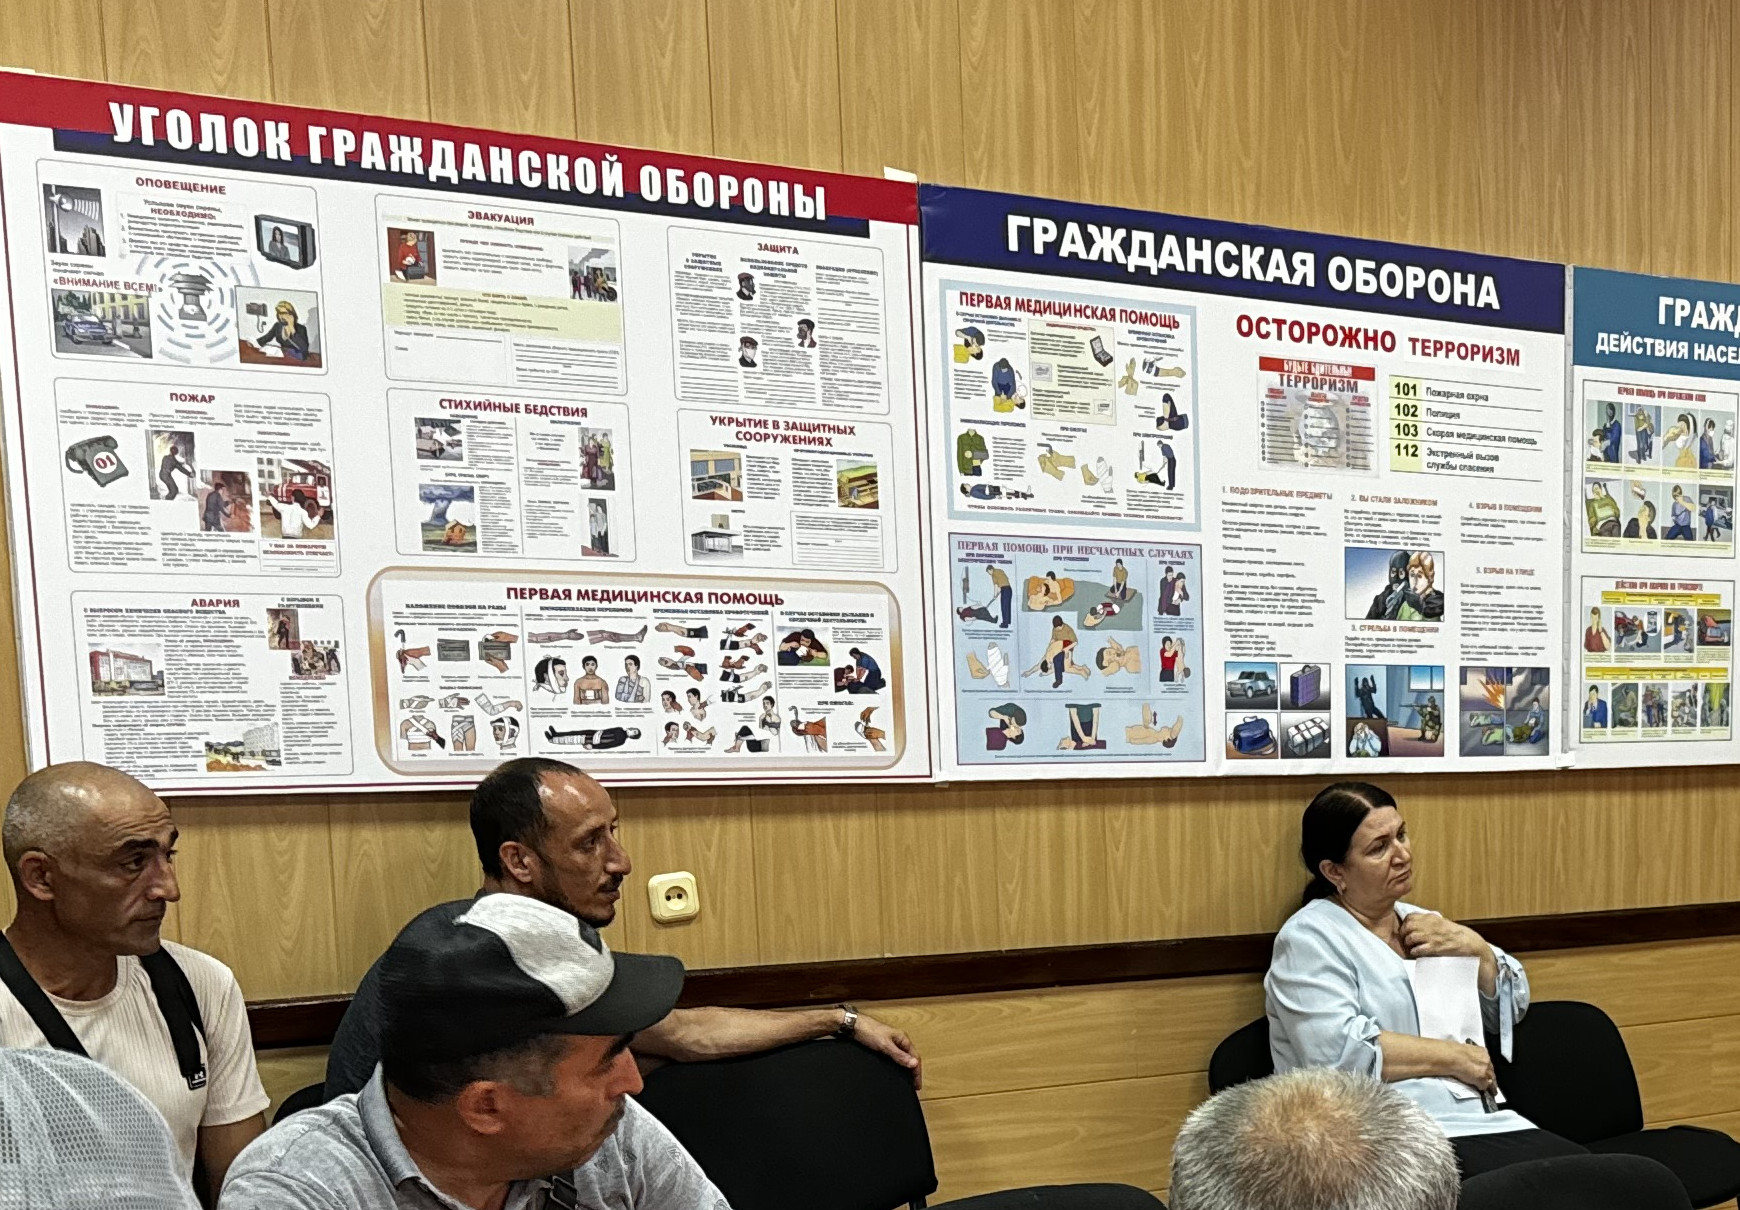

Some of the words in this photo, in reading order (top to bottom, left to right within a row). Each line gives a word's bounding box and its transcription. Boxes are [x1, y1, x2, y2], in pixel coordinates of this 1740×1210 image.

[108, 101, 292, 161] УГОЛОК
[307, 125, 625, 198] ГРАЖДАНСКОЙ
[639, 164, 826, 221] ОБОРОНЫ
[135, 176, 227, 195] ОПОВЕЩЕНИЕ
[467, 210, 535, 226] ЭВАКУАЦИЯ
[757, 242, 799, 256] ЗАЩИТА
[1007, 214, 1315, 287] ГРАЖДАНСКАЯ
[1327, 256, 1501, 310] ОБОРОНА
[53, 277, 120, 291] «ВНИМАНИЕ
[959, 291, 1012, 311] ПЕРВАЯ
[1015, 297, 1116, 323] МЕДИЦИНСКАЯ
[1119, 309, 1181, 331] ПОМОЩЬ
[1236, 314, 1397, 353] ОСТОРОЖНО
[1408, 336, 1521, 367] ТЕРРОРИЗМ
[1595, 331, 1689, 360] ДЕЙСТВИЯ
[1278, 373, 1359, 393] ТЕРРОРИЗМ
[1394, 382, 1417, 397] 101
[1426, 386, 1464, 400] Пожарная
[169, 392, 216, 404] ПОЖАР
[438, 398, 521, 414] СТИХИЙНЫЕ
[524, 403, 589, 418] БЕДСТВИЯ
[1394, 403, 1418, 417] 102
[1426, 407, 1460, 419] Полиция
[709, 415, 769, 429] УКРЫТИЕ
[773, 420, 781, 430] В
[783, 421, 857, 436] ЗАЩИТНЫХ
[1394, 422, 1418, 437] 103
[1426, 427, 1454, 439] Скорая
[1456, 431, 1506, 443] медицинская
[1508, 436, 1537, 446] помощь
[735, 431, 834, 447] СООРУЖЕНИЯХ
[1394, 443, 1418, 457] 112
[1426, 447, 1473, 460] Экстренный
[1426, 461, 1457, 472] службы
[1459, 463, 1494, 473] спасения
[957, 540, 999, 551] ПЕРВАЯ
[1003, 543, 1048, 555] ПОМОЩЬ
[1052, 544, 1073, 554] ПРИ
[1077, 545, 1144, 557] НЕСЧАСТНЫХ
[1148, 549, 1194, 560] СЛУЧАЯХ
[190, 598, 241, 609] АВАРИЯ
[506, 587, 572, 600] ПЕРВАЯ
[576, 588, 704, 604] МЕДИЦИНСКАЯ
[708, 592, 785, 608] ПОМОЩЬ
